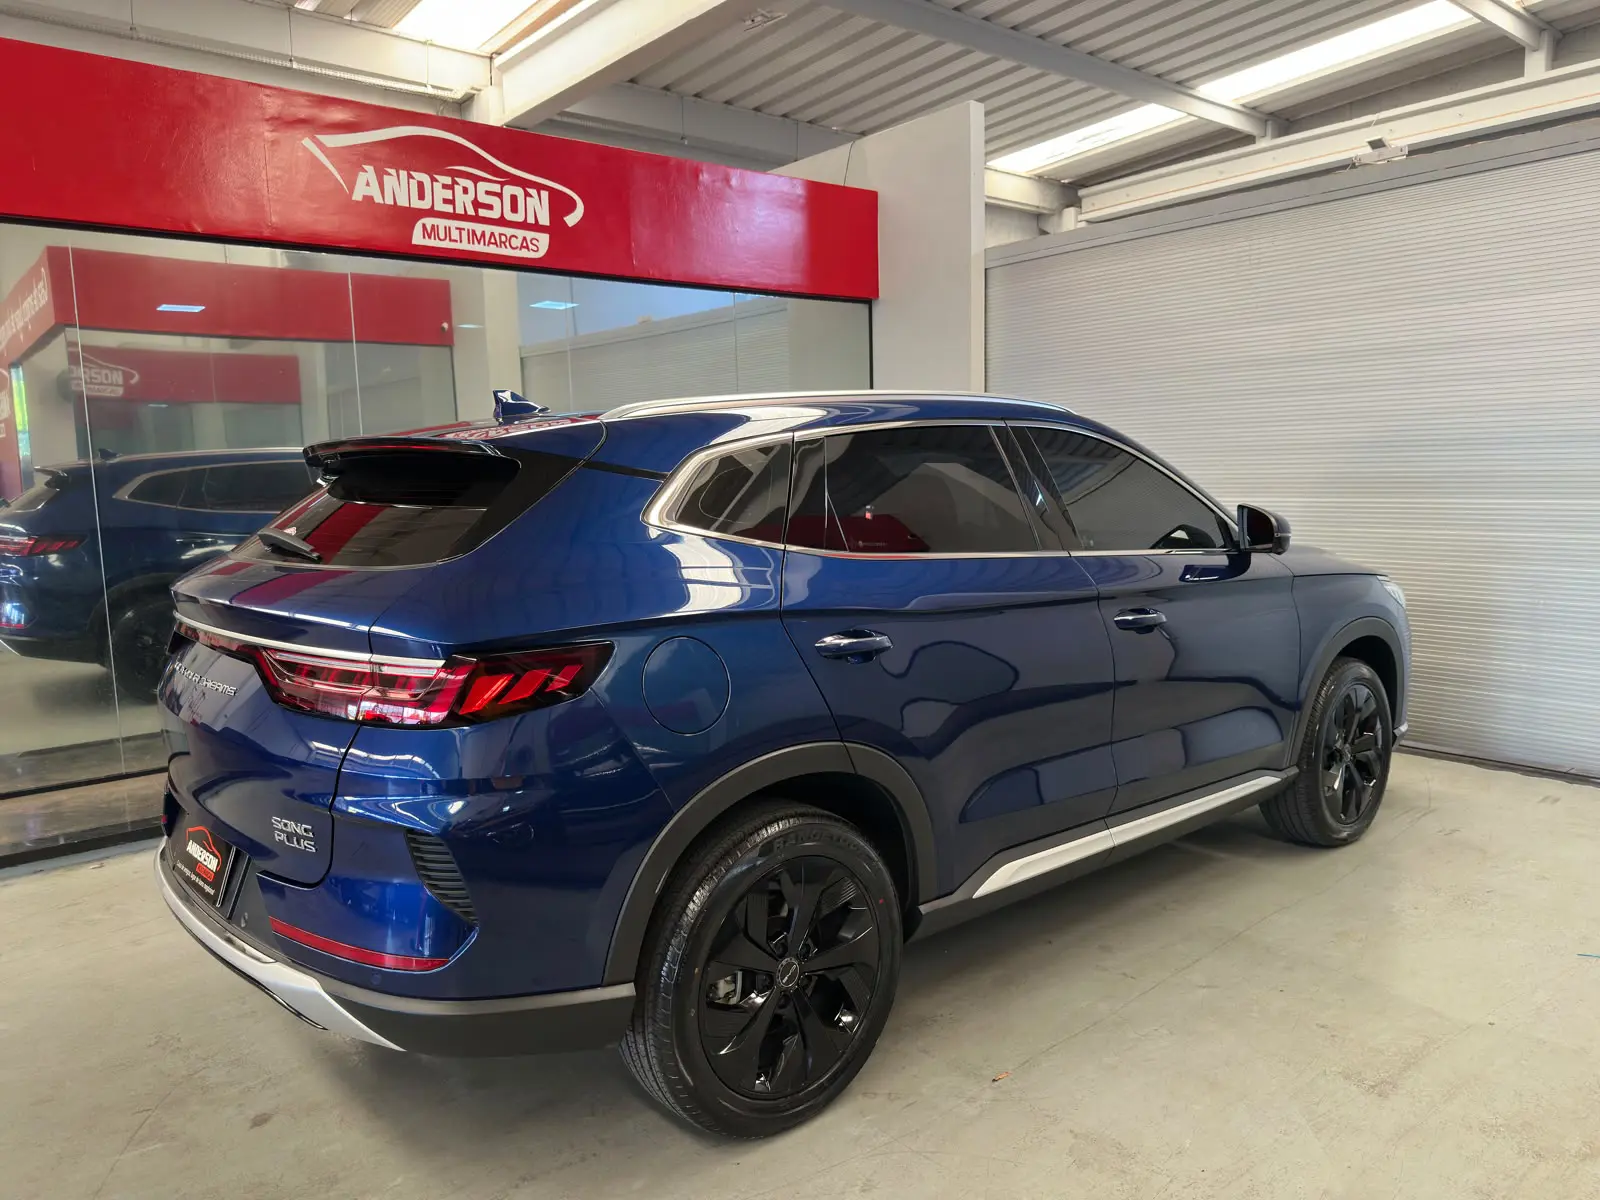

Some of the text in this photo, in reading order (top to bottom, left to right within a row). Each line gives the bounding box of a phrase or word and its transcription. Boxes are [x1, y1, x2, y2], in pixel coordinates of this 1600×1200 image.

[352, 165, 550, 226] ANDERSON
[421, 223, 540, 252] MULTIMARCAS
[271, 816, 314, 837] SONG
[186, 840, 218, 872] ANDERSON
[274, 831, 316, 852] PLUS
